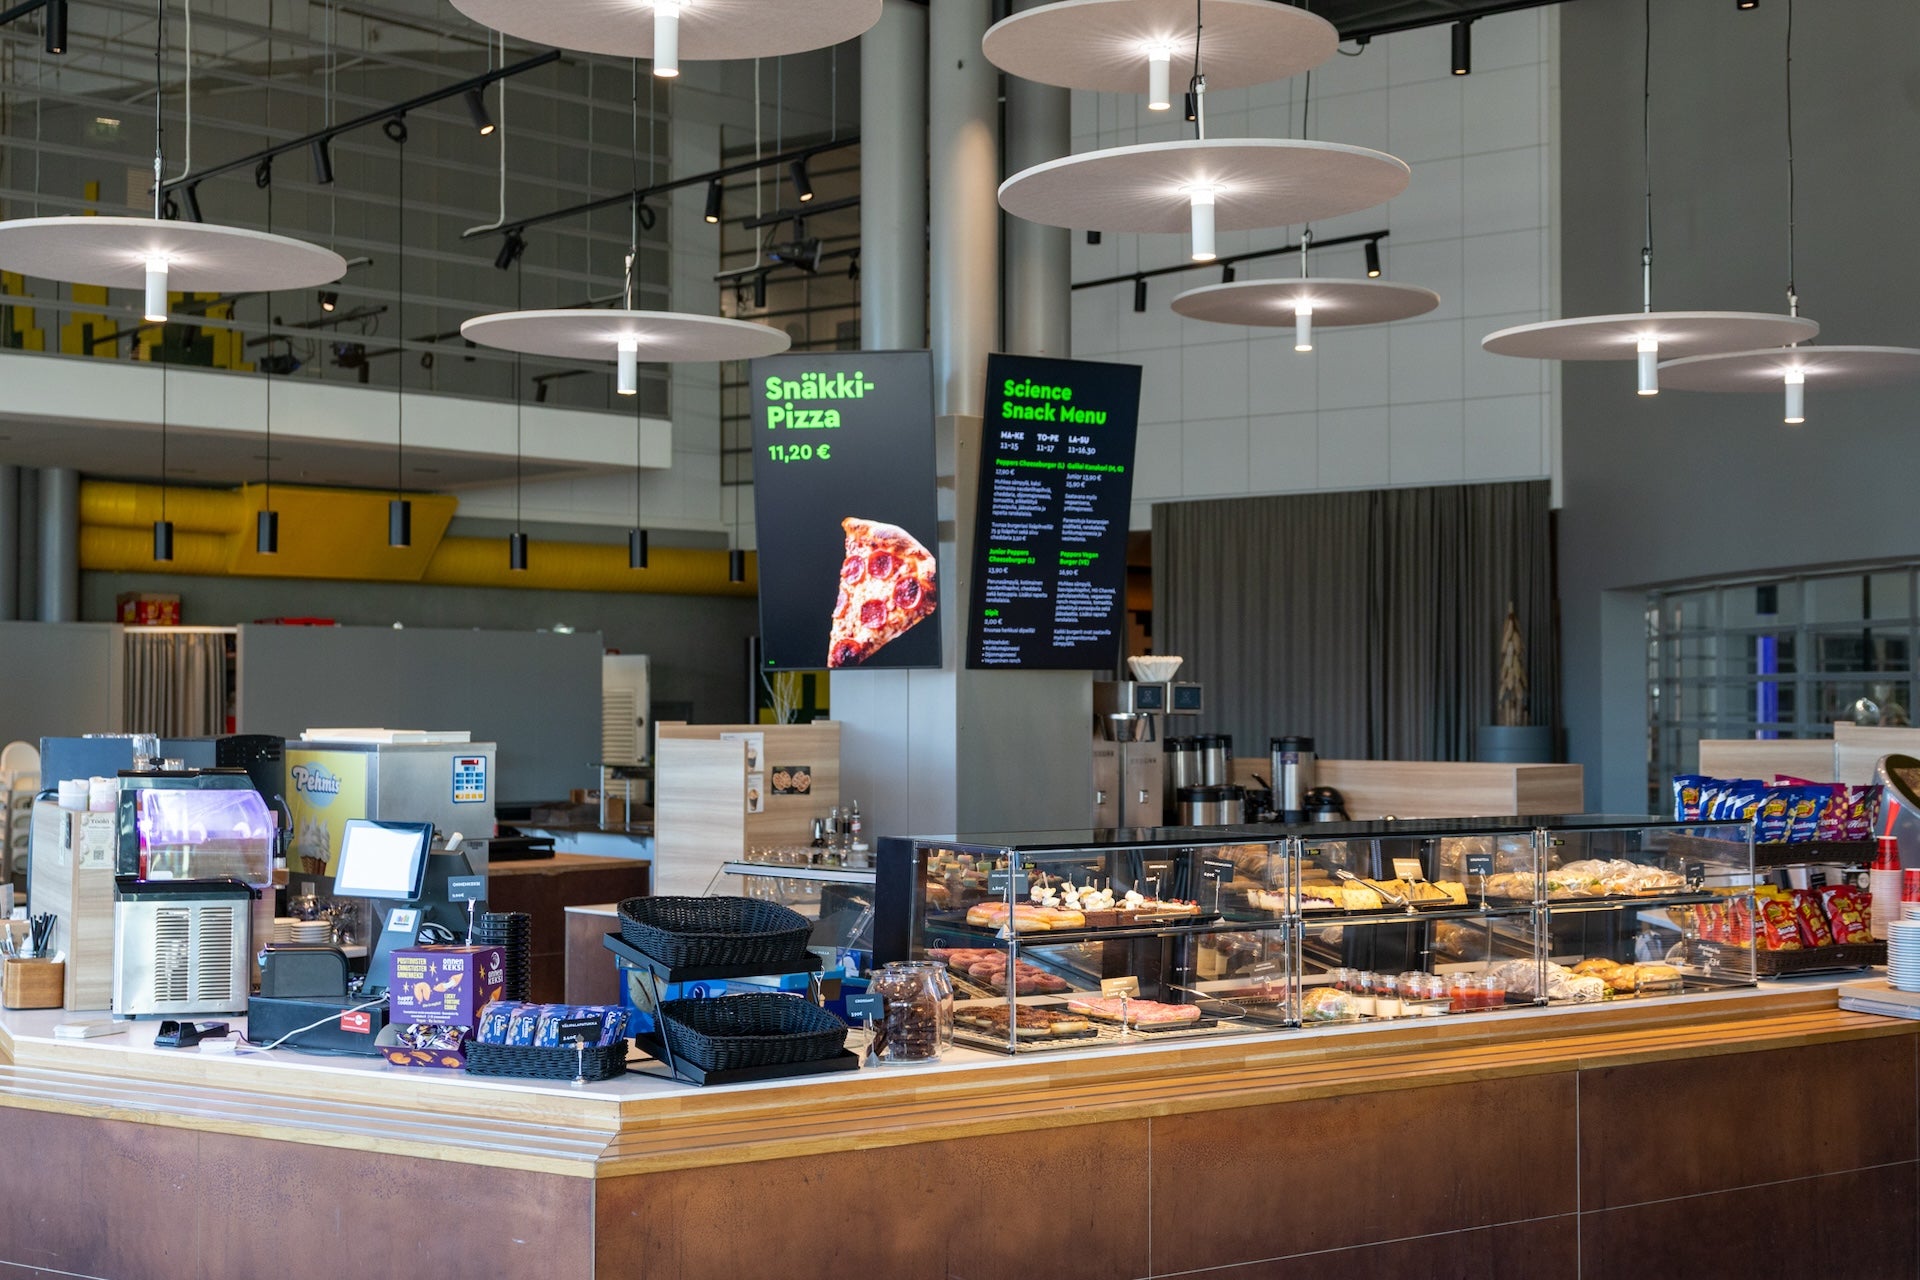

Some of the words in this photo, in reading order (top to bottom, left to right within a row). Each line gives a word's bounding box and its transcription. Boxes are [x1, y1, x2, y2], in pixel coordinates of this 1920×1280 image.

[766, 371, 874, 400] Snäkki-
[1004, 378, 1072, 400] Science
[767, 402, 840, 429] Pizza
[1002, 401, 1056, 421] Snack
[1060, 405, 1106, 425] Menu
[1000, 442, 1019, 450] 11-15
[1036, 444, 1054, 453] 11-17
[1001, 431, 1024, 440] MA-KE
[1037, 434, 1059, 442] TO-PE
[1069, 436, 1090, 444] LA-SU
[768, 445, 812, 464] 11,20
[816, 444, 831, 460] €
[1019, 460, 1056, 469] Cheeseburger
[292, 765, 340, 794] Pehmis
